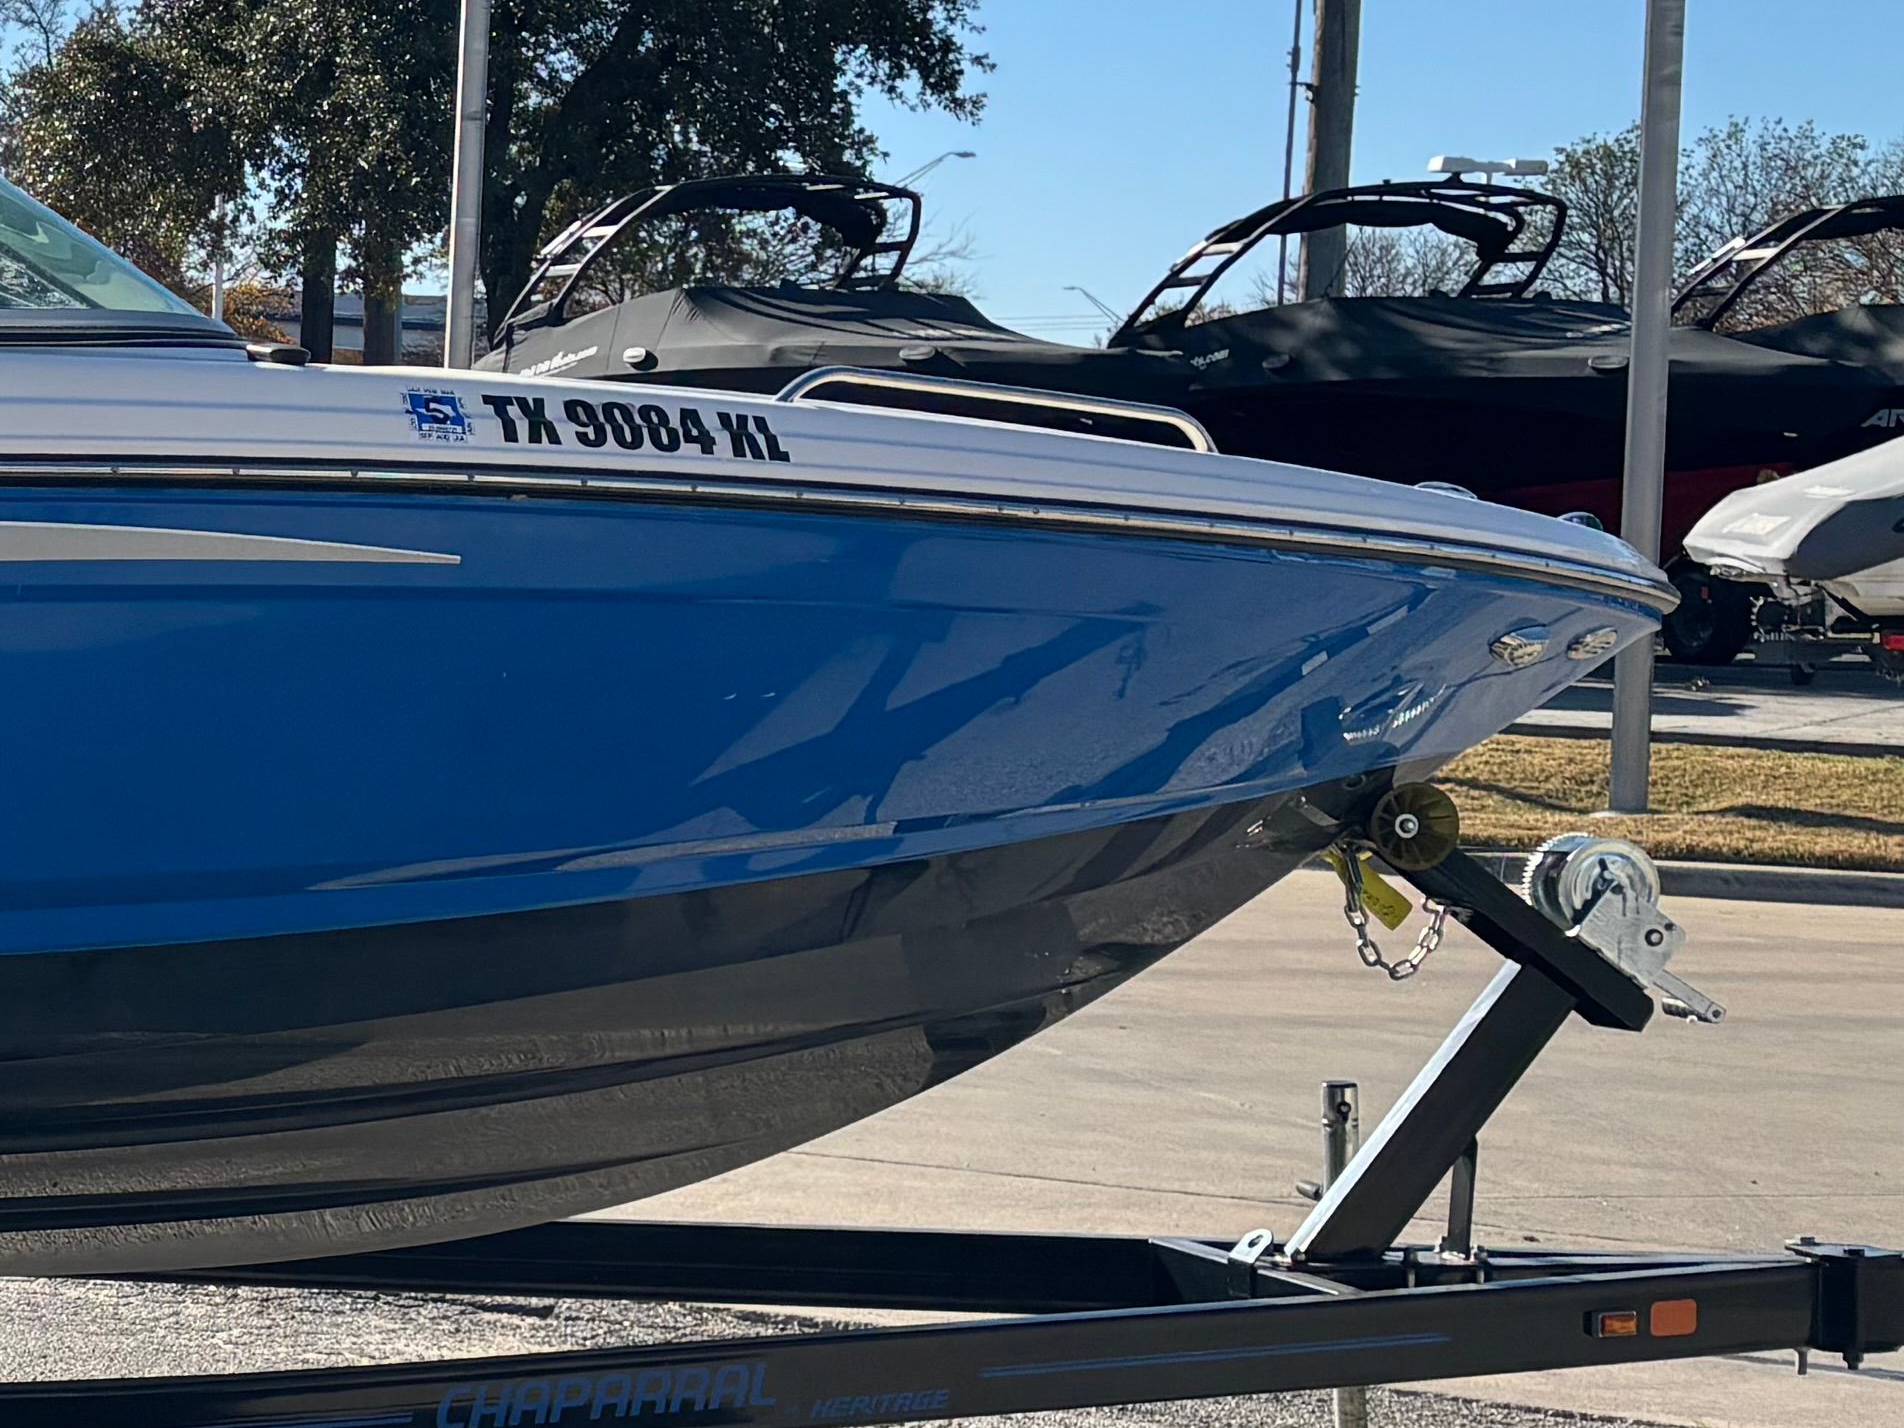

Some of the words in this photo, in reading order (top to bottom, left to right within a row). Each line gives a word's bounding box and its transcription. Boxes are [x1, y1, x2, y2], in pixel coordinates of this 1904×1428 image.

[480, 394, 562, 445] TX
[563, 399, 716, 455] 9084
[715, 412, 791, 463] KL
[810, 1388, 951, 1420] HERITAGE
